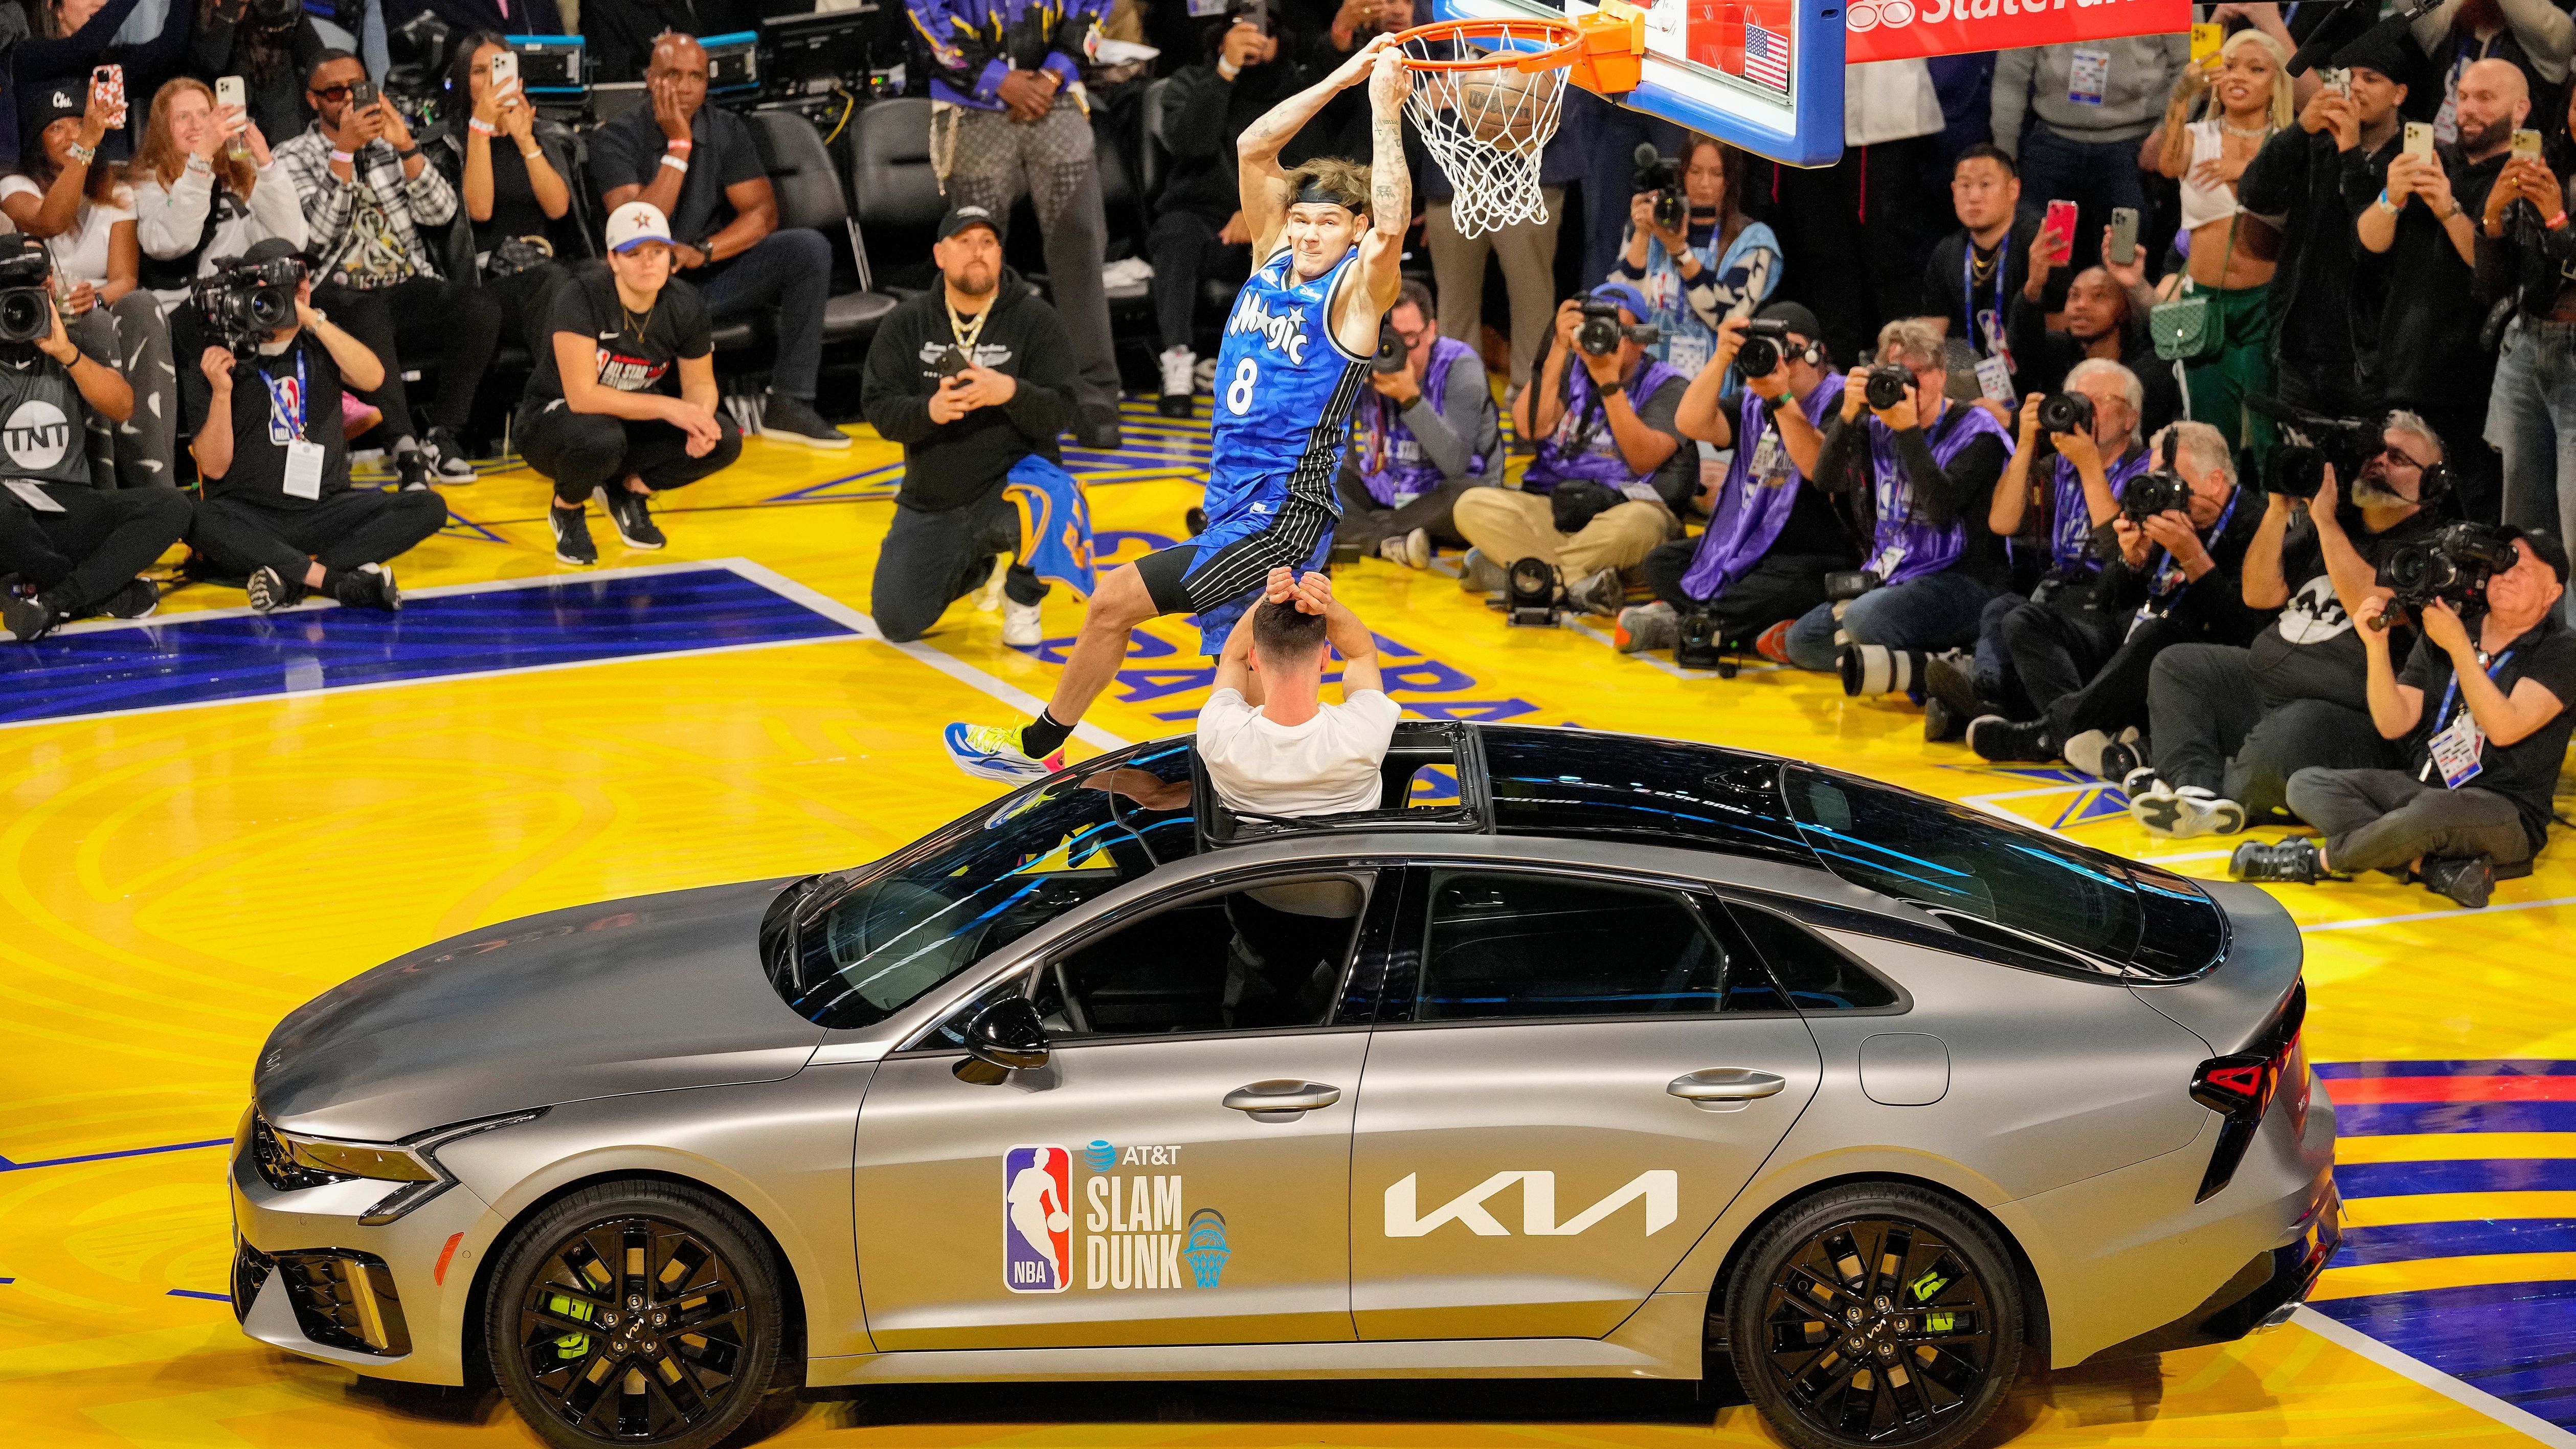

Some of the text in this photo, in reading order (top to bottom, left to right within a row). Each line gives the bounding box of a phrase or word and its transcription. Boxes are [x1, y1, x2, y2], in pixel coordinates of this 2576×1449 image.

[1226, 357, 1258, 416] 8
[3, 422, 67, 451] TNT
[1122, 1145, 1181, 1166] AT&T
[1086, 1175, 1182, 1232] SLAM
[1384, 1170, 1678, 1237] KIA
[1014, 1261, 1046, 1284] NBA
[1086, 1234, 1183, 1290] DUNK
